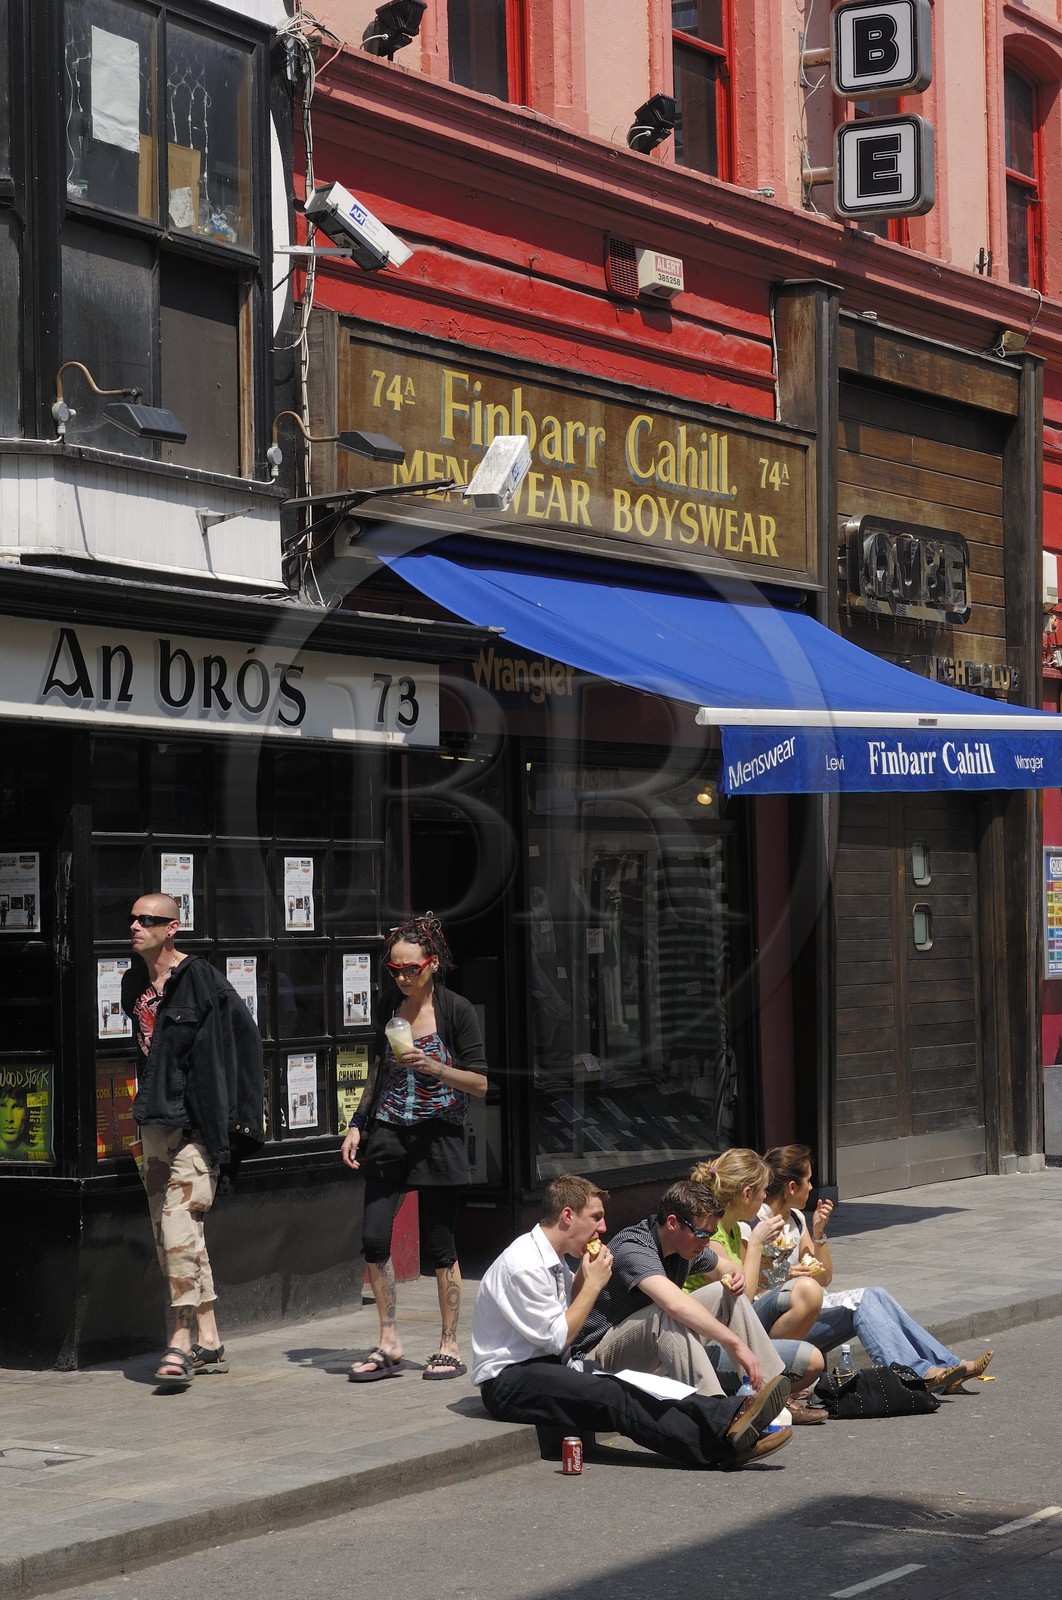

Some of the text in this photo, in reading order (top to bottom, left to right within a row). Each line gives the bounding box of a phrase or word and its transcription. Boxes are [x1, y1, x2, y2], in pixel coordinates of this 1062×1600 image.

[350, 207, 367, 223] ADT
[656, 257, 681, 275] ALERT
[657, 273, 681, 286] 385258
[441, 368, 606, 471] Finbarr
[392, 449, 780, 557] MENEAR BOYSWEAR
[862, 532, 968, 612] QUBE
[373, 673, 420, 727] 73
[471, 647, 575, 704] Wrangler
[728, 736, 1044, 790] Menswear Levi Finbarr Cahill Wrangler
[114, 1085, 134, 1098] SCREW
